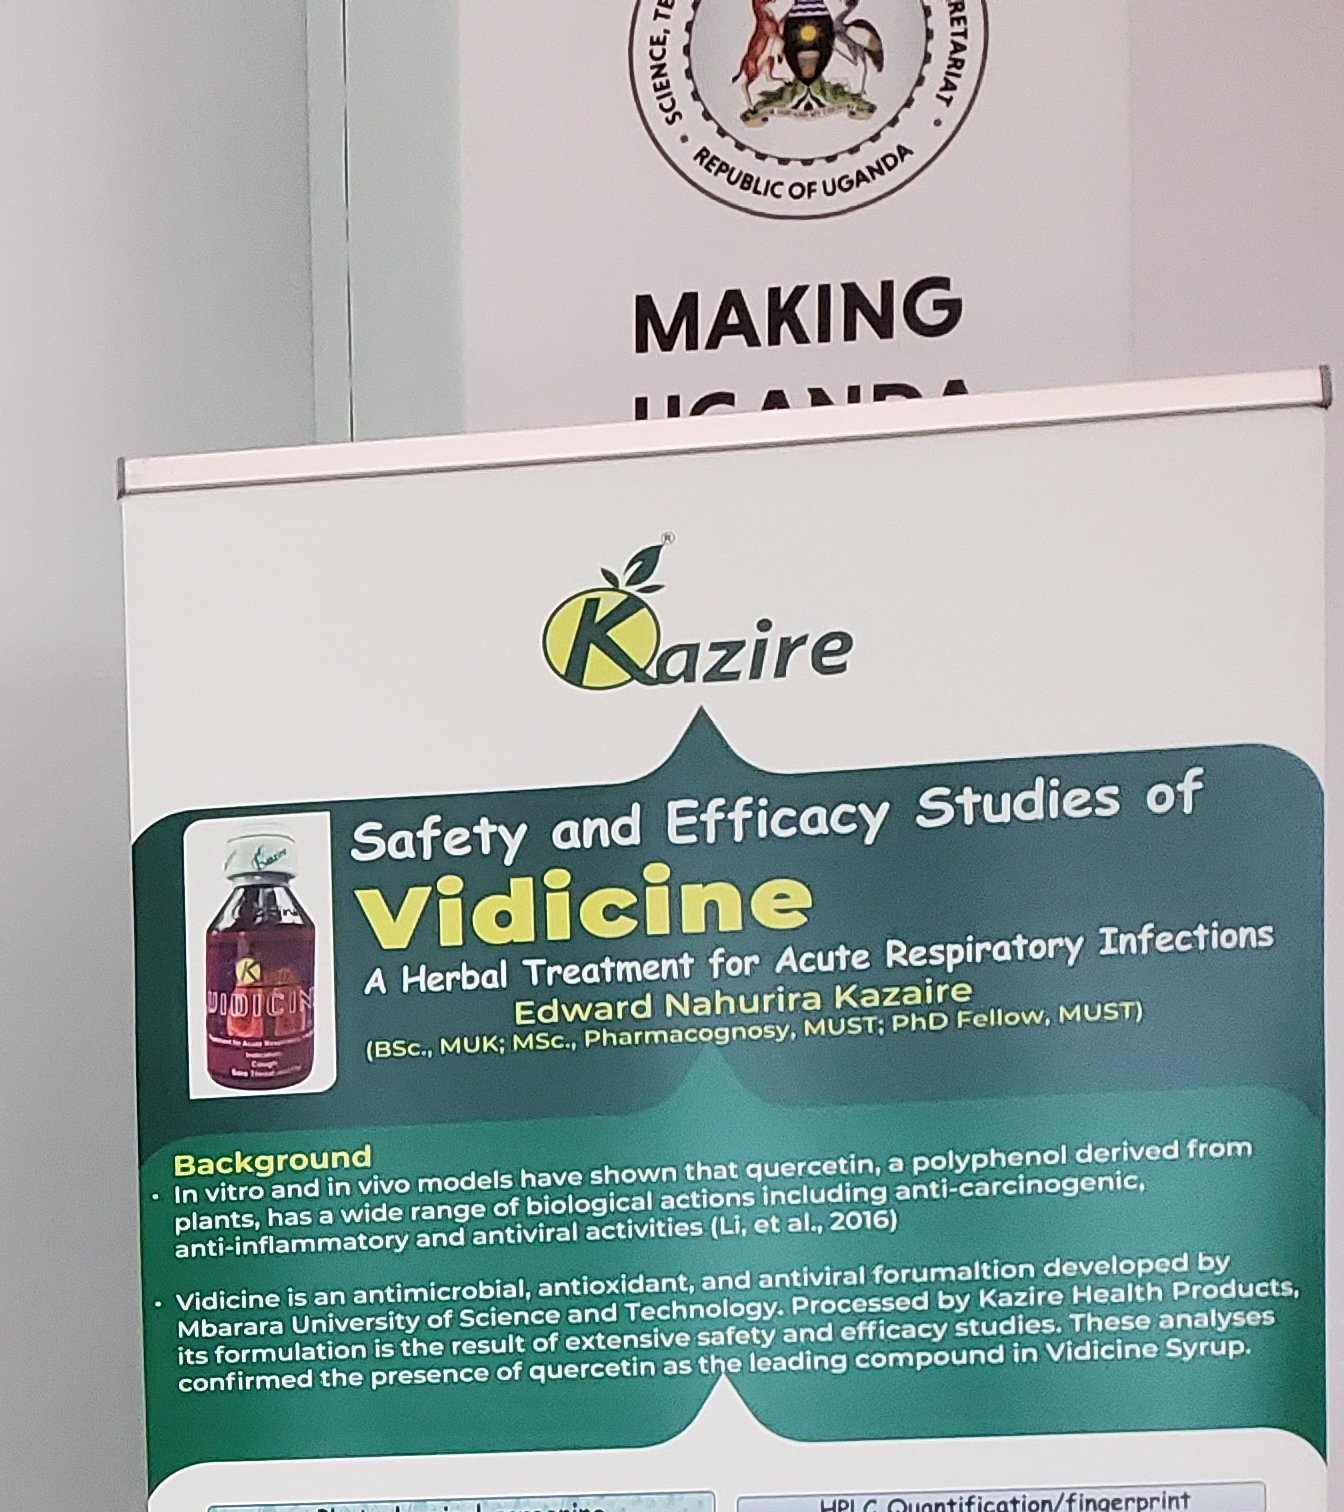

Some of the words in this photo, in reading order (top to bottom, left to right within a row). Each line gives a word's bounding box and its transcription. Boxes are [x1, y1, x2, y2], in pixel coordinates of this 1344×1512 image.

[649, 29, 683, 125] SCIENCE,
[936, 0, 968, 107] RETARIAT
[693, 146, 784, 199] REPUBLIC
[789, 182, 817, 199] OF
[822, 144, 914, 197] UGANDA
[636, 276, 962, 353] MAKING
[541, 586, 854, 691] Kazire
[351, 815, 527, 866] Safety
[552, 802, 640, 849] and
[668, 797, 889, 844] Efficacy
[915, 777, 1120, 827] Studies
[1147, 767, 1203, 814] of
[353, 863, 812, 950] Vidicine
[364, 968, 386, 995] A
[403, 960, 506, 992] Herbal
[522, 953, 694, 985] Treatment
[709, 948, 760, 978] for
[776, 945, 871, 973] Acute
[886, 934, 1084, 973] Respiratory
[1099, 921, 1274, 954] Infections
[441, 1035, 504, 1054] MUK;
[805, 1017, 883, 1036] MUST;
[893, 1013, 948, 1032] PhD
[1060, 1000, 1144, 1022] MUST)
[516, 993, 651, 1024] Edward
[664, 986, 820, 1017] Nahurira
[836, 978, 972, 1008] Kazaire
[174, 1145, 371, 1177] Background
